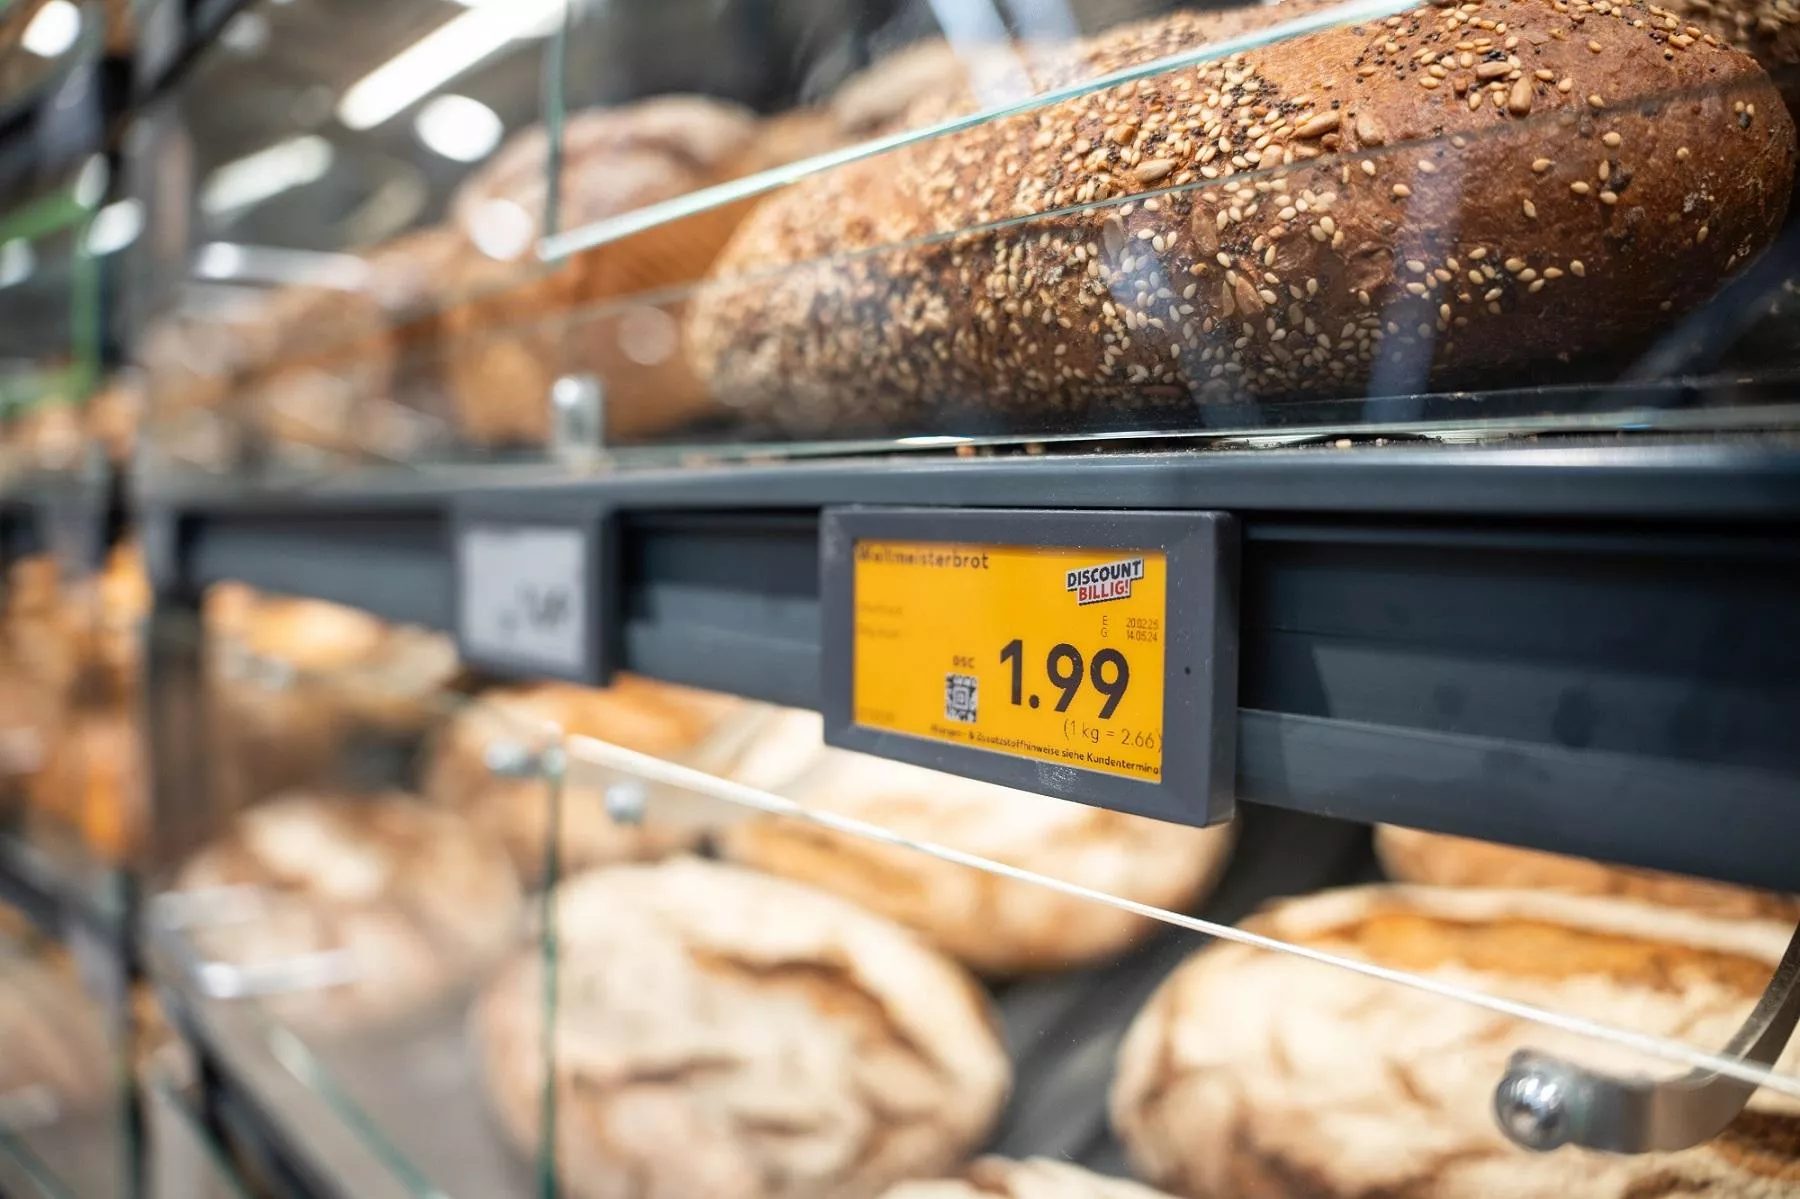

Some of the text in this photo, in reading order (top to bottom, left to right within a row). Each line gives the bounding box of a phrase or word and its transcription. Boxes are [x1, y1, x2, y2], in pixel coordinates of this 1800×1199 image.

[1067, 559, 1141, 588] DISCOUNT
[1078, 579, 1129, 601] BILLIG!
[1101, 627, 1108, 638] G
[1102, 615, 1108, 625] E
[1000, 639, 1130, 720] 1.99
[1063, 718, 1077, 741] (1
[1082, 721, 1100, 744] kg
[1061, 749, 1085, 761] siehe
[1087, 752, 1160, 775] Kundentermina
